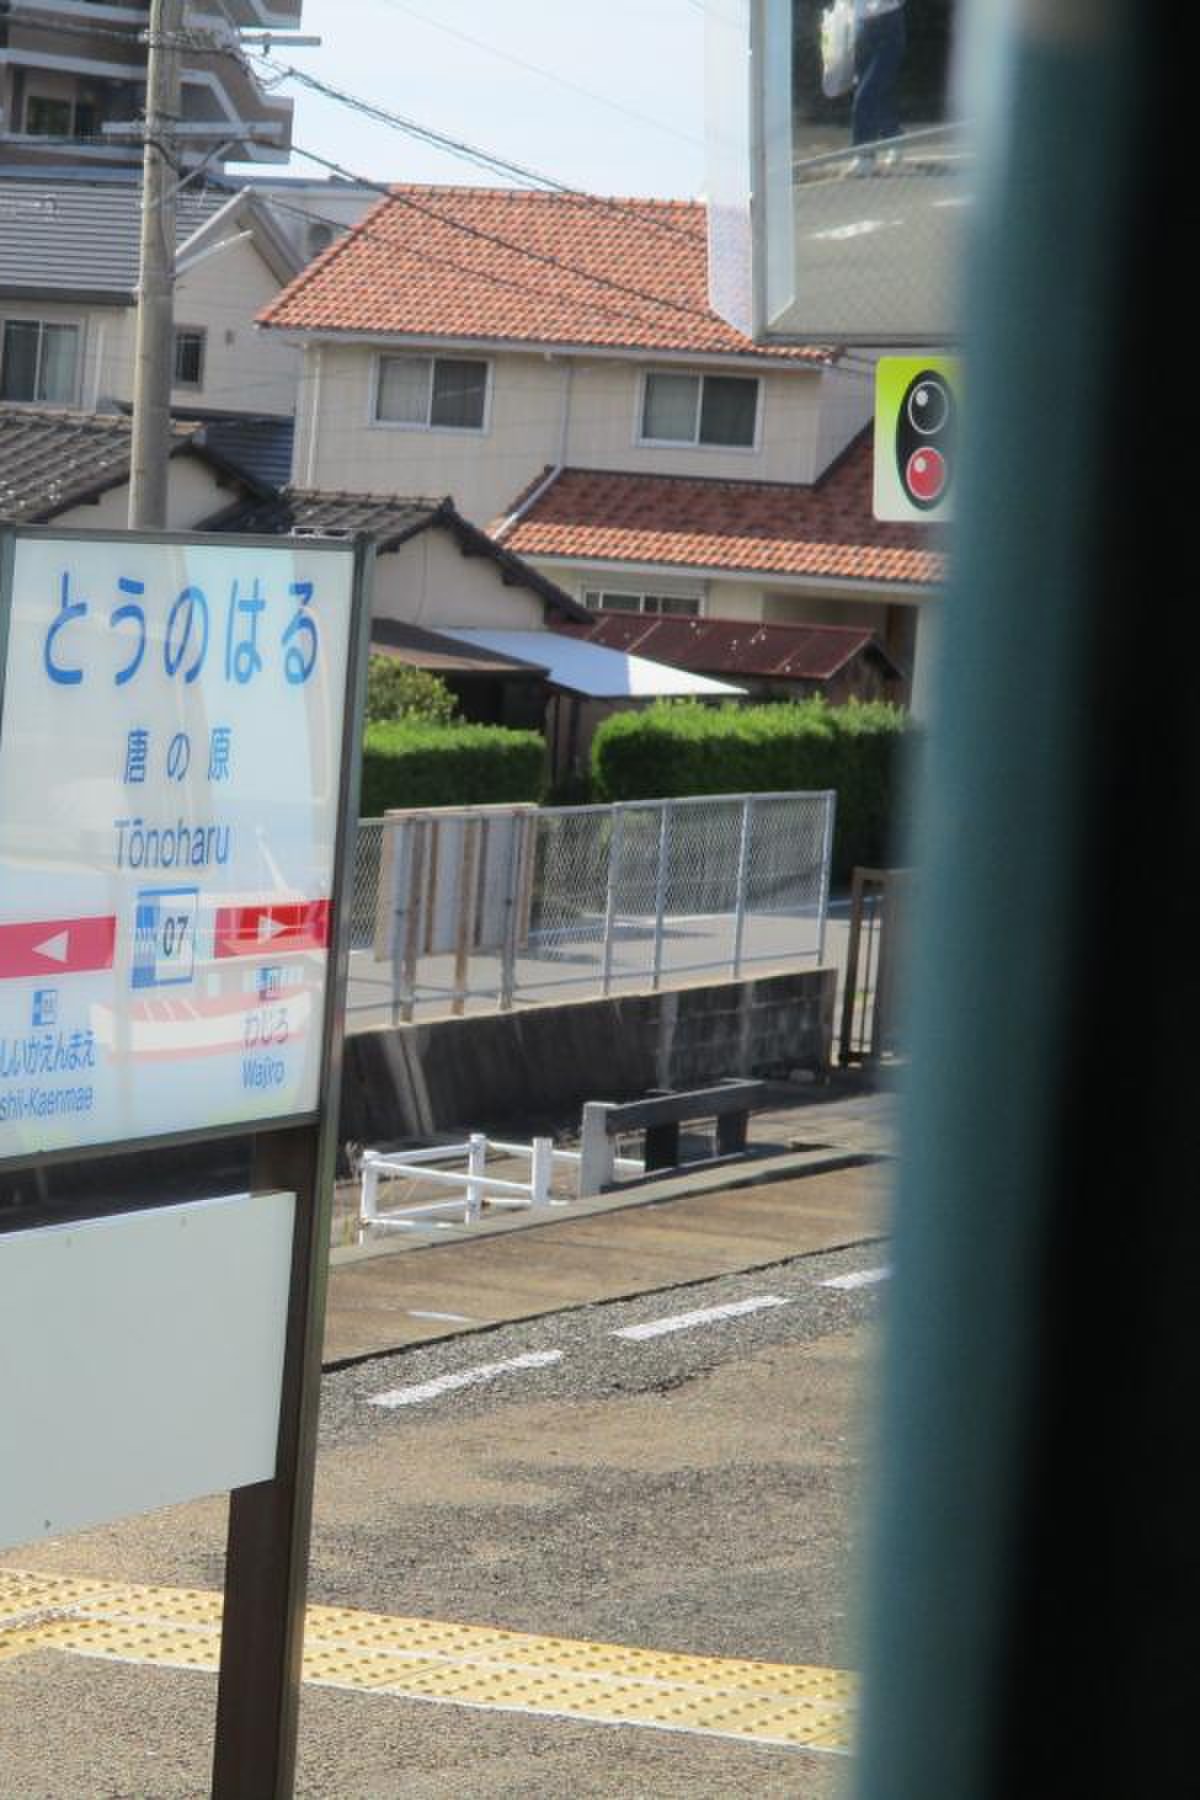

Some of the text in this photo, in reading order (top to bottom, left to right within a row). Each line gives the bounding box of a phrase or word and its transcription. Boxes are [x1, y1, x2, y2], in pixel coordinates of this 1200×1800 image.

[44, 571, 317, 685] とうのはる
[123, 728, 232, 785] 唐の原
[113, 818, 230, 868] Tōnoharu
[162, 915, 189, 957] 07
[242, 1056, 285, 1089] Wajiro
